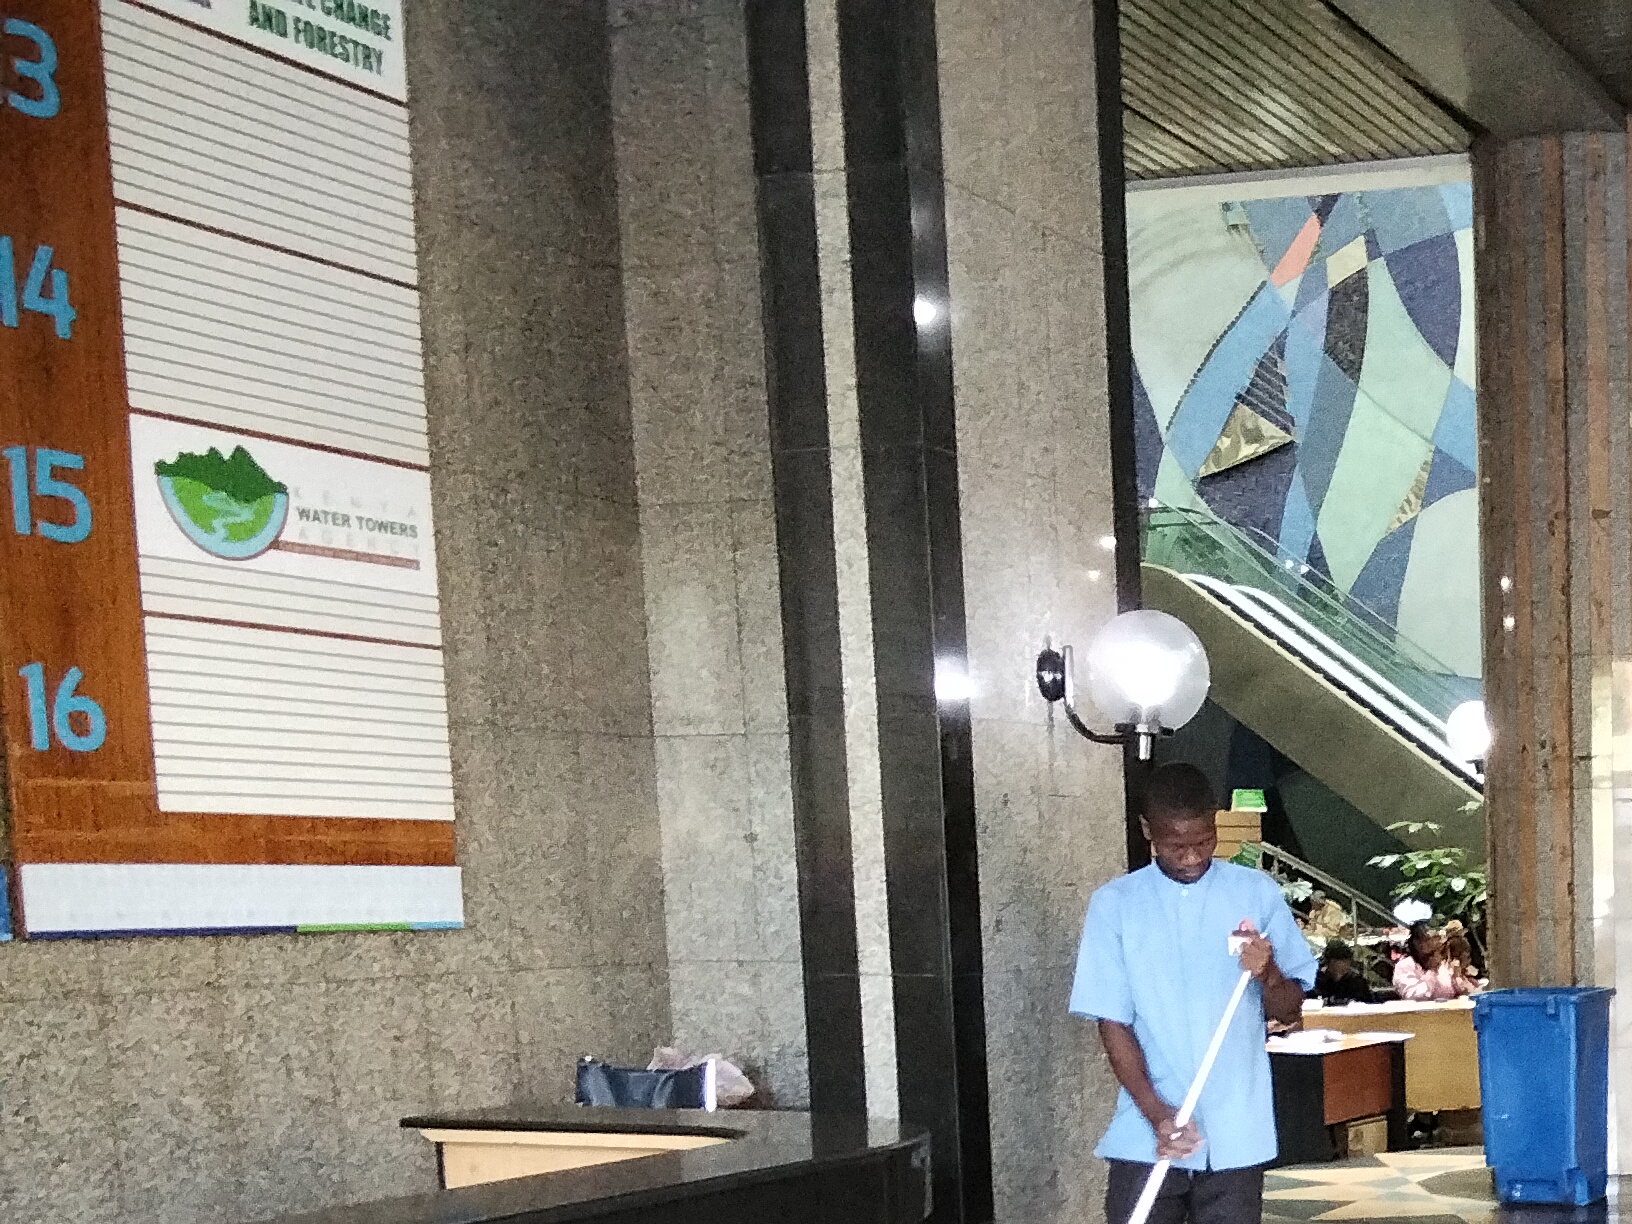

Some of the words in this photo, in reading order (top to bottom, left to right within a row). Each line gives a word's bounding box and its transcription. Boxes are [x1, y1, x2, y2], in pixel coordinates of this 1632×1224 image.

[248, 0, 288, 38] AND
[293, 16, 385, 76] FORESTRY
[0, 235, 77, 340] 14
[1, 446, 93, 543] 15
[296, 505, 352, 529] WATER
[356, 515, 418, 539] TOWERS
[18, 662, 107, 752] 16
